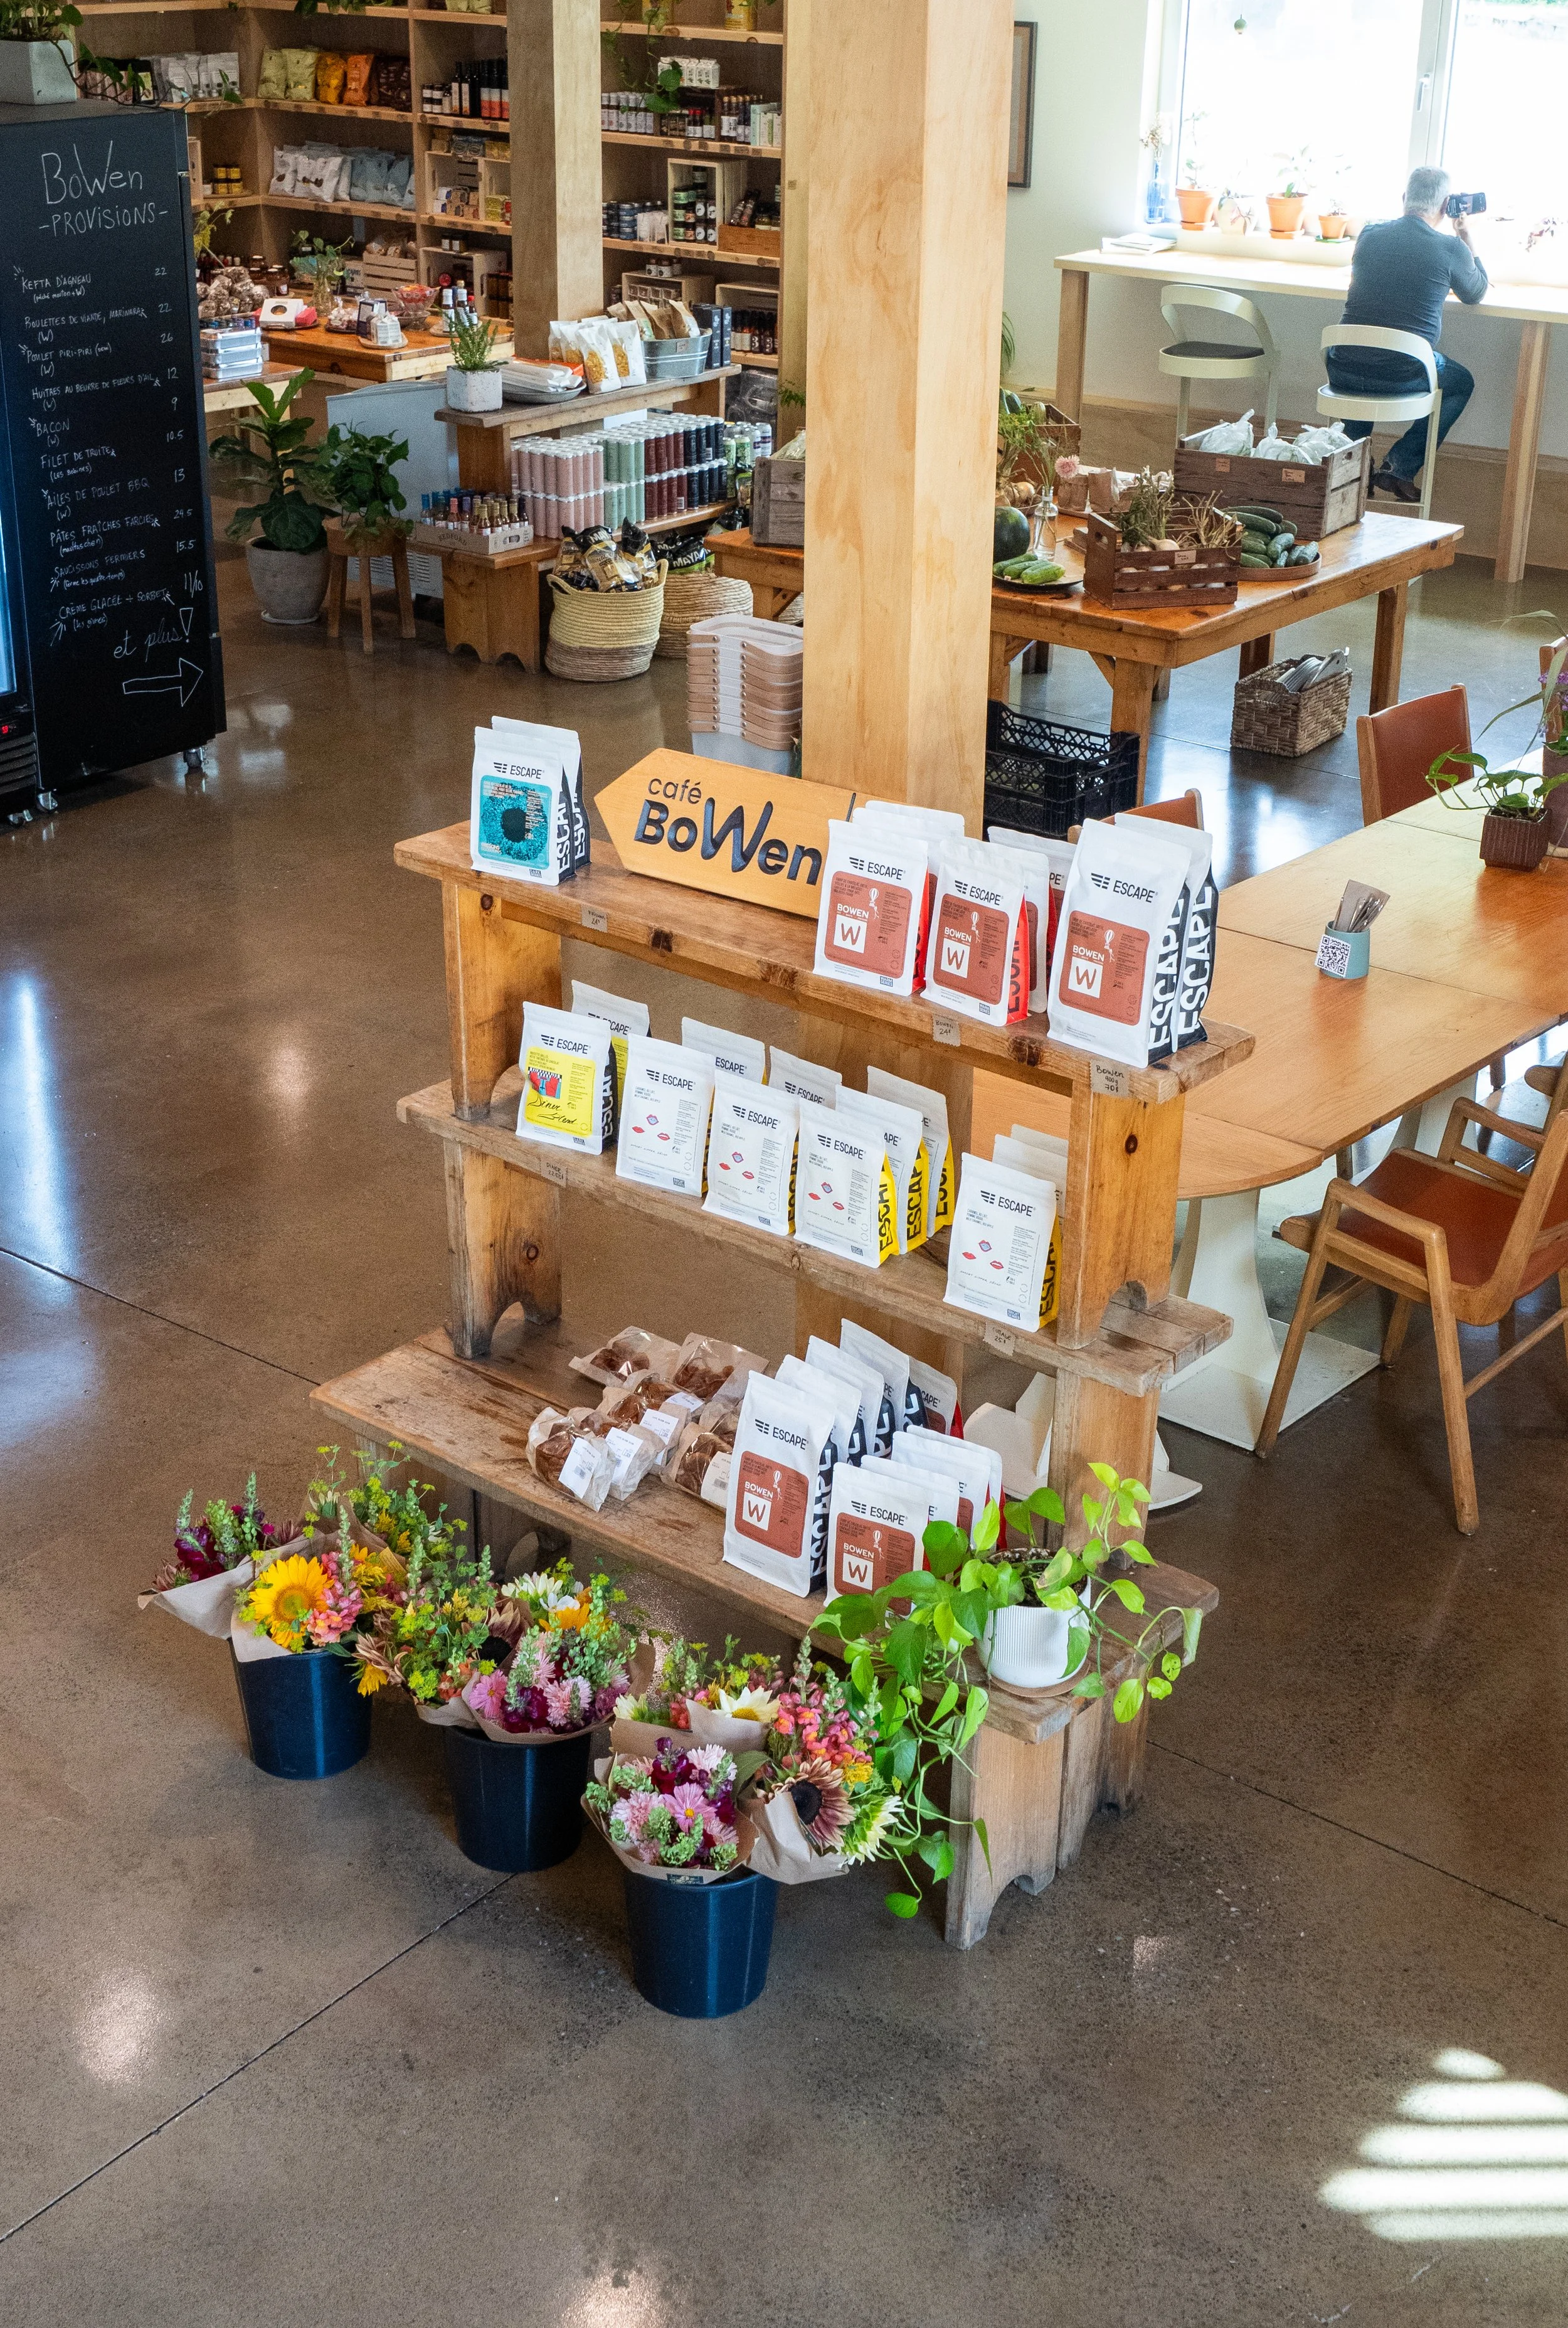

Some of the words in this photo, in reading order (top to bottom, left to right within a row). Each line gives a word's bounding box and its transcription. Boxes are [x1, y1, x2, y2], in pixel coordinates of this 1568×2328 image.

[156, 268, 167, 276] 22
[22, 277, 51, 293] KEFTA
[56, 274, 91, 287] D'AGNEAU
[159, 304, 172, 313] 22
[24, 317, 65, 329] BOULETTES
[38, 329, 53, 344] (W)
[161, 333, 173, 343] 26
[27, 350, 54, 363] POULET
[40, 362, 55, 376] (W)
[168, 367, 178, 379] 12
[76, 381, 99, 393] BEURRE
[171, 396, 178, 410] 9
[36, 418, 70, 437] BACON
[166, 430, 184, 442] 10.5
[41, 452, 70, 469] FILET
[73, 451, 83, 462] DE
[174, 469, 186, 482] 13
[75, 489, 87, 501] DE
[92, 482, 120, 498] POULET
[127, 477, 150, 492] BBQ
[176, 539, 196, 553] 15.5
[105, 549, 146, 565] FERMIERS
[137, 588, 167, 602] SORBET
[114, 630, 137, 658] et
[510, 765, 542, 779] ESCAPE
[648, 778, 702, 804] café
[633, 797, 822, 886] BoWen
[867, 862, 903, 880] ESCAPE
[969, 886, 1001, 905] ESCAPE
[1113, 880, 1155, 903] ESCAPE
[837, 903, 869, 919] BOWEN
[841, 923, 861, 945] W
[944, 927, 972, 943] BOWEN
[948, 947, 965, 970] W
[1073, 944, 1104, 962] BOWEN
[1076, 966, 1096, 989] W
[557, 1038, 589, 1055] ESCAPE
[715, 1056, 745, 1075] ESCAPE
[1096, 1065, 1124, 1078] Bowen
[662, 1074, 694, 1091] ESCAPE
[748, 1110, 779, 1130] ESCAPE
[834, 1140, 865, 1159] ESCAPE
[999, 1196, 1033, 1217] ESCAPE
[772, 1426, 807, 1450] ESCAPE
[744, 1481, 774, 1499] BOWEN
[748, 1500, 766, 1523] W
[871, 1506, 905, 1526] ESCAPE
[844, 1543, 874, 1559] BOWEN
[848, 1561, 867, 1583] W
